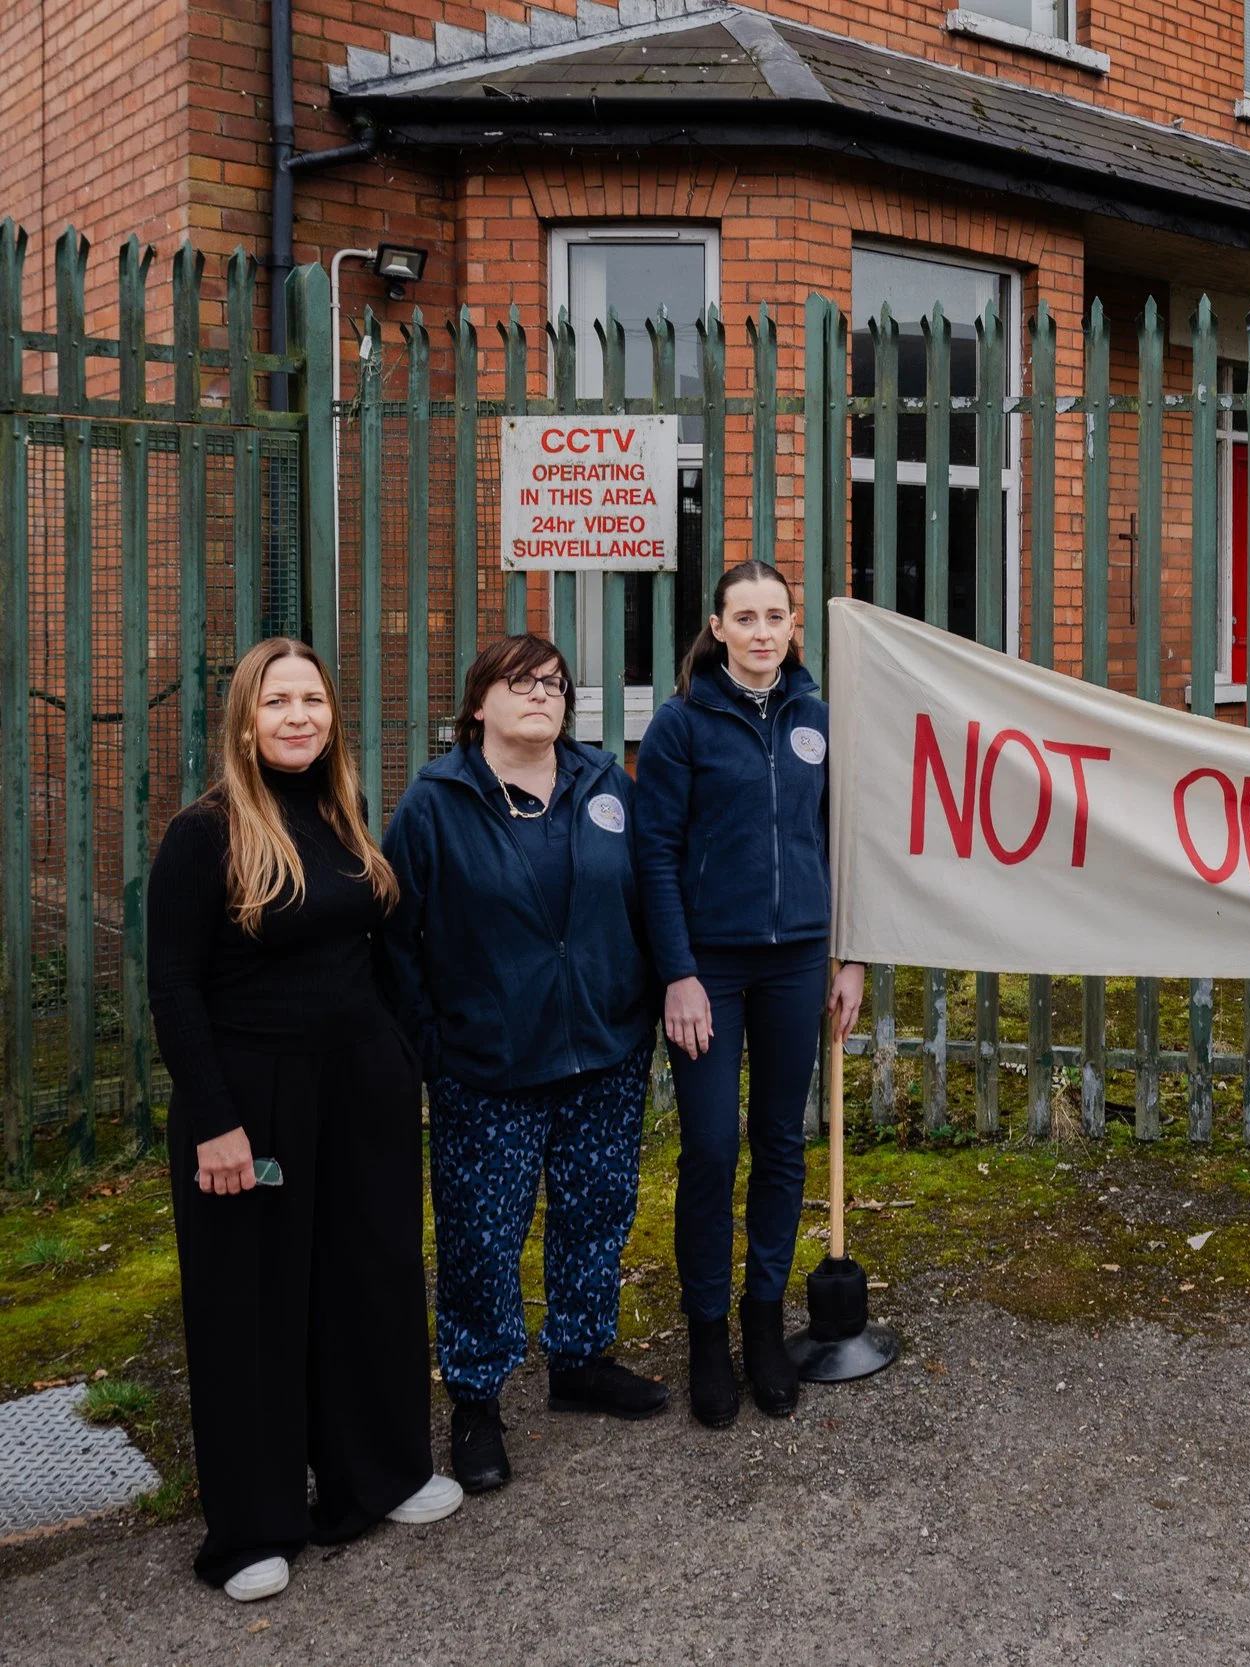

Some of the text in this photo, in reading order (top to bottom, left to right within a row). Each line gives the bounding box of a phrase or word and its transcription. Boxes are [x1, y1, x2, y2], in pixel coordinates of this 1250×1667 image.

[541, 428, 636, 454] CCTV
[532, 463, 645, 482] OPERATING
[520, 488, 657, 506] IN THIS AREA
[531, 516, 645, 533] 24hr VIDEO
[513, 539, 665, 558] SURVEILLANCE
[909, 712, 1112, 868] NOT
